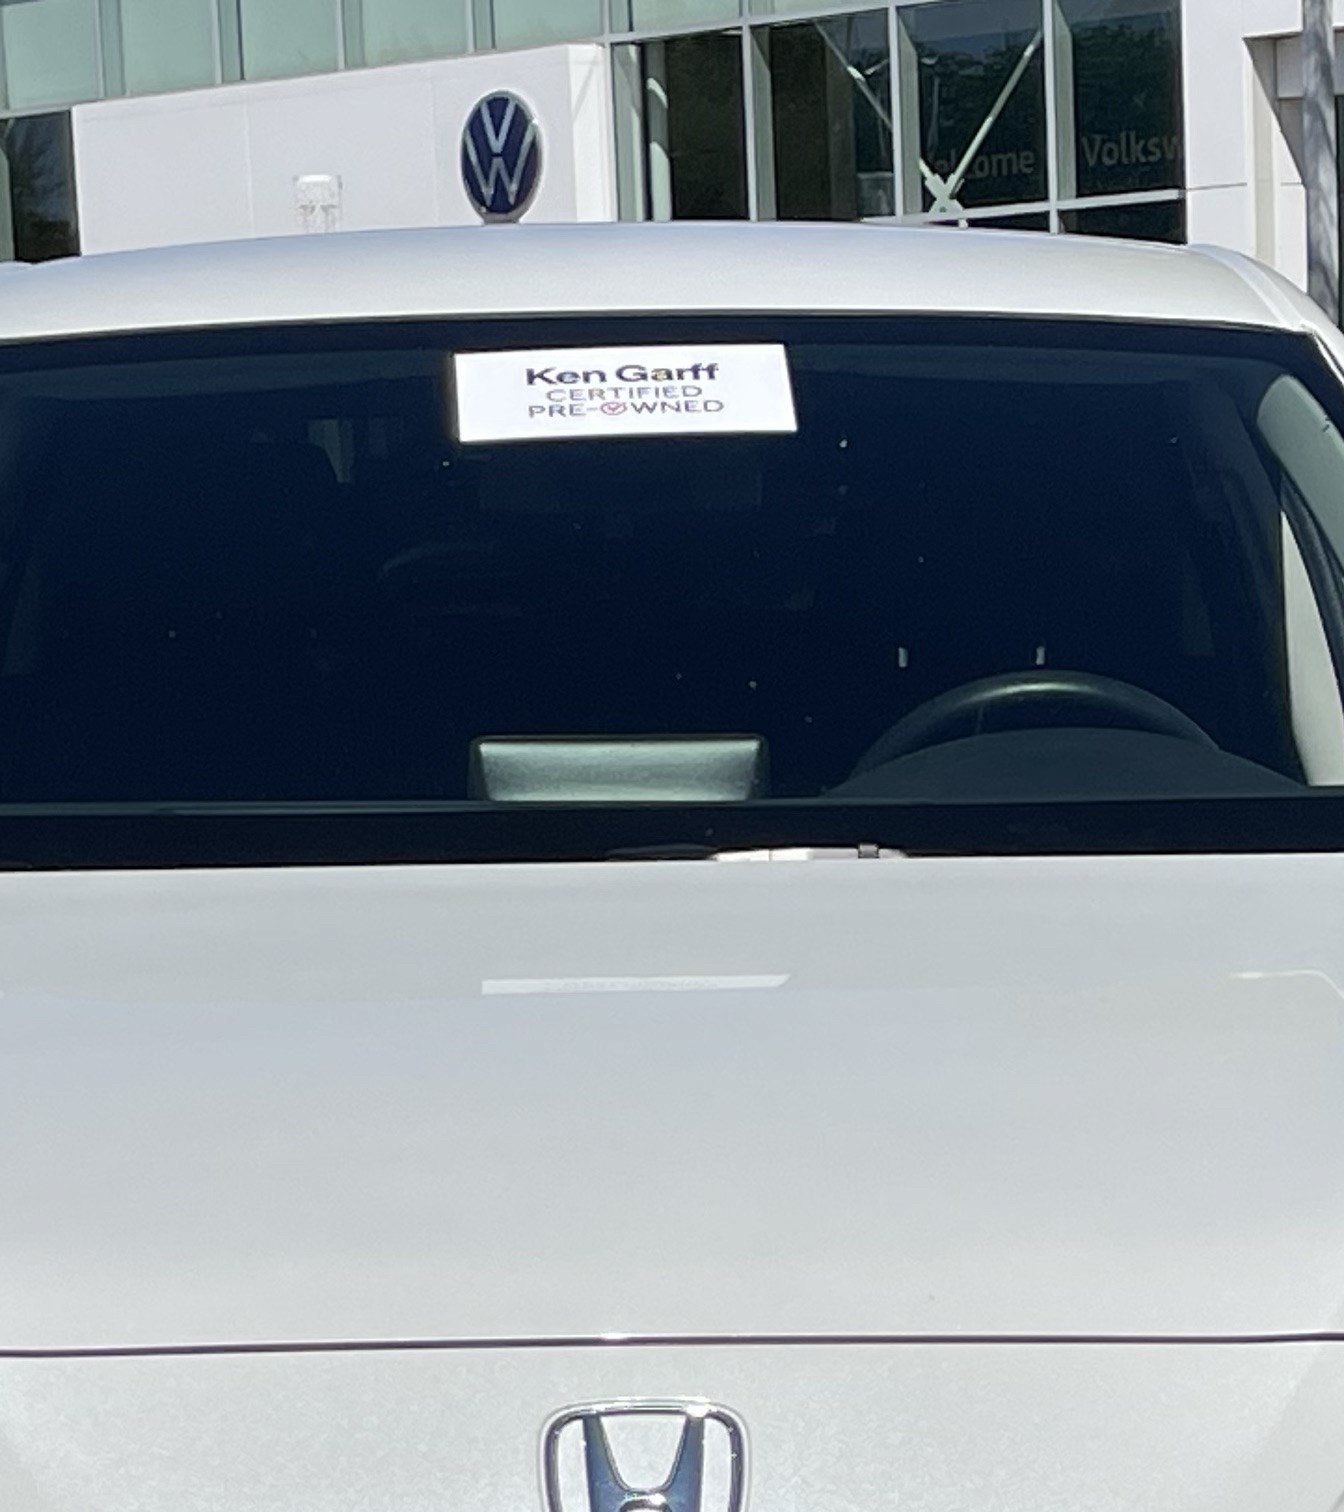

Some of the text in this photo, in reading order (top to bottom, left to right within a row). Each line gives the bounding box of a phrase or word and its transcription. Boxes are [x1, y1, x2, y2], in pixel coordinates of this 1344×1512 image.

[526, 362, 720, 385] Ken Garff
[546, 385, 703, 402] CERTIFIED
